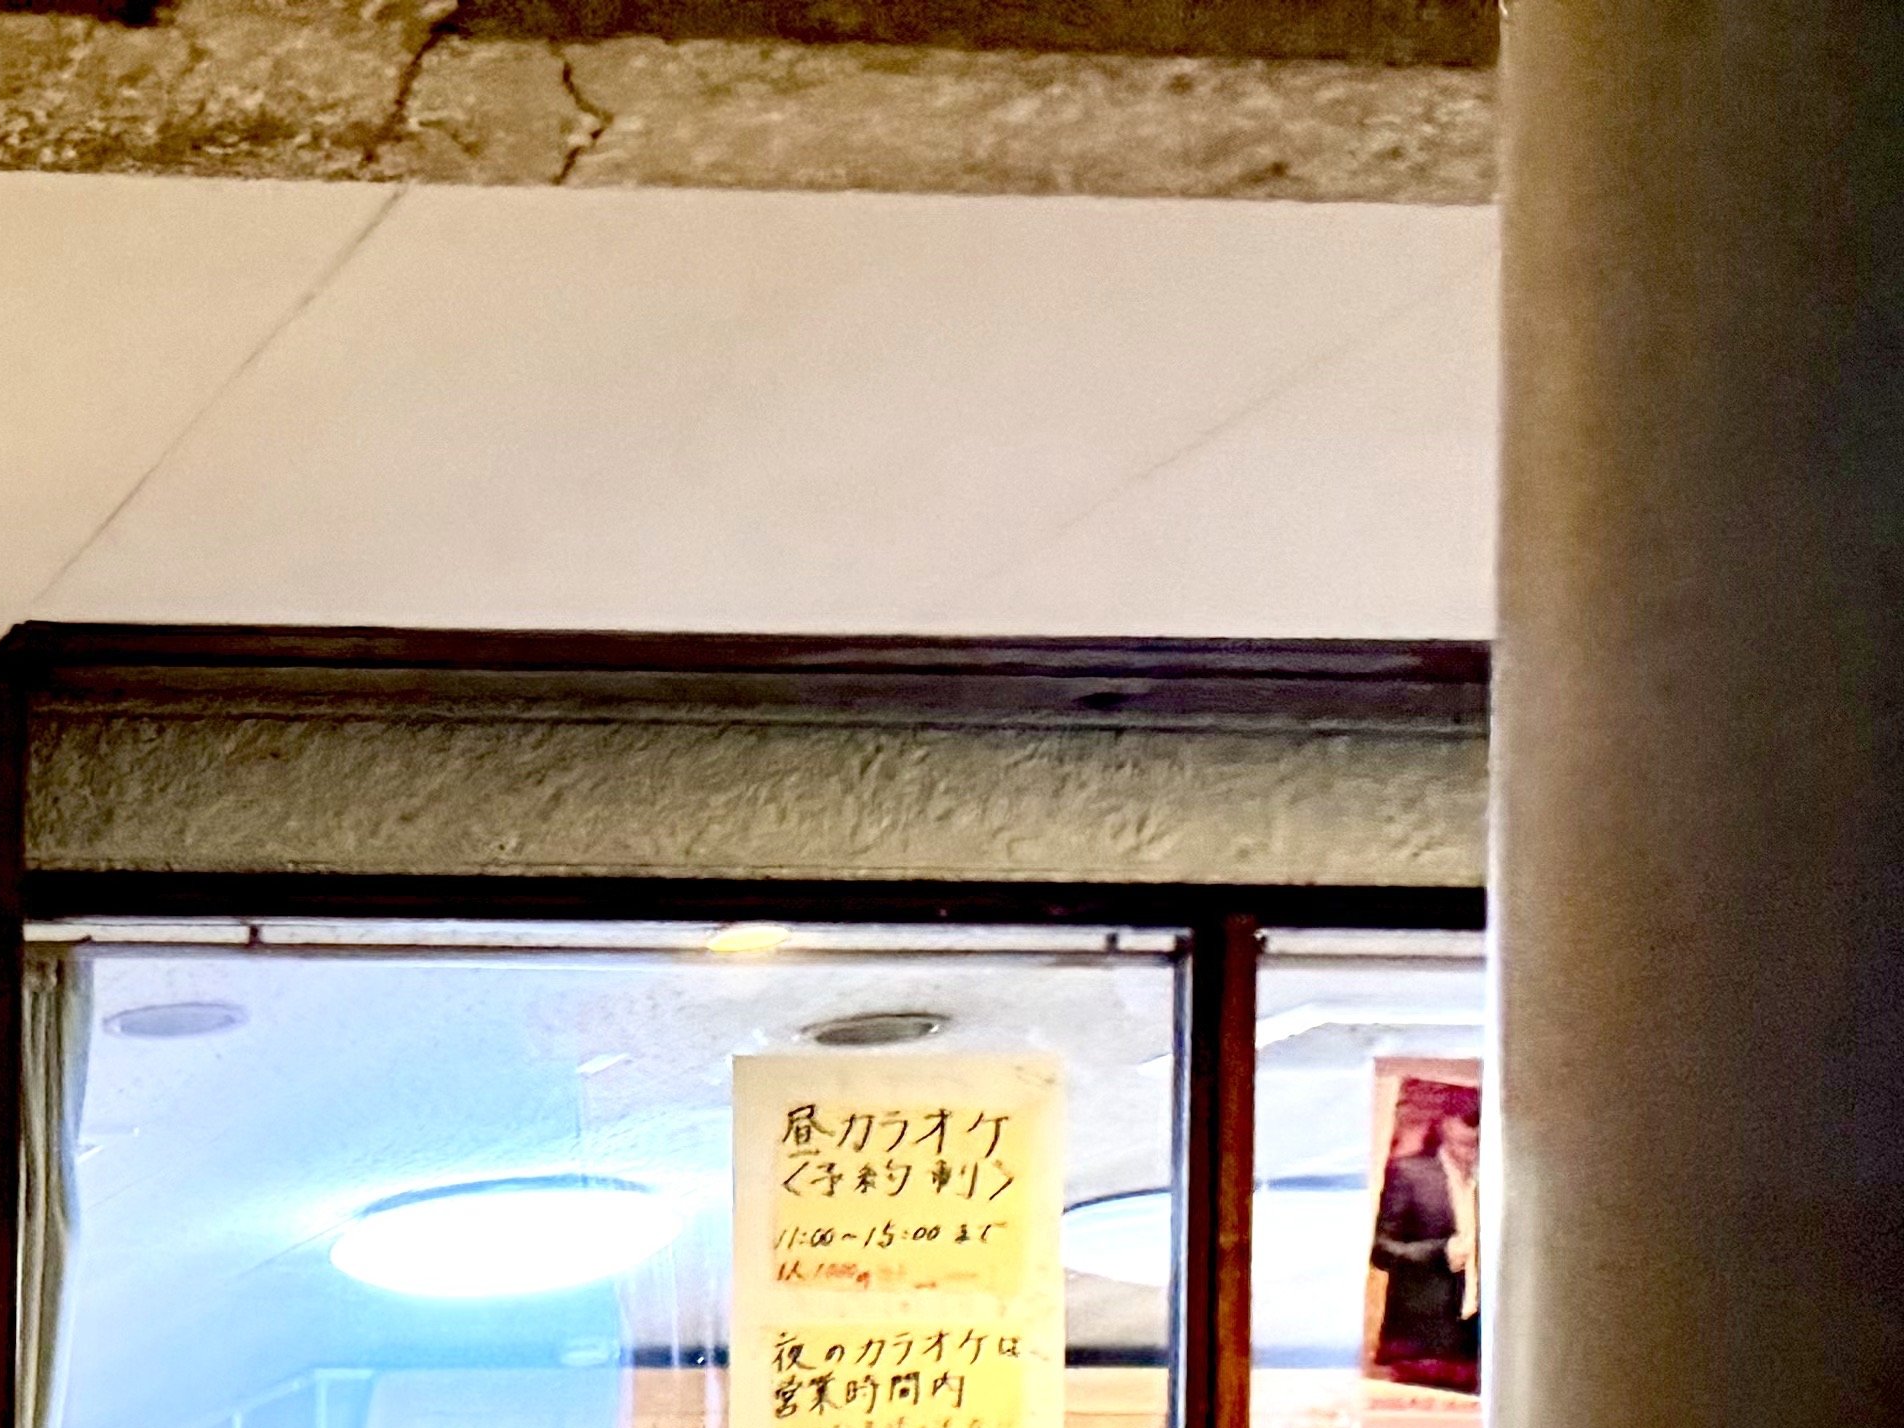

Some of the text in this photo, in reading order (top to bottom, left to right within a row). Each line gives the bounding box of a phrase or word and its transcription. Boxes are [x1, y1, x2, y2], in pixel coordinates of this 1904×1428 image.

[780, 1103, 1010, 1159] 昼カラオケ
[774, 1370, 966, 1419] 営業時間内
